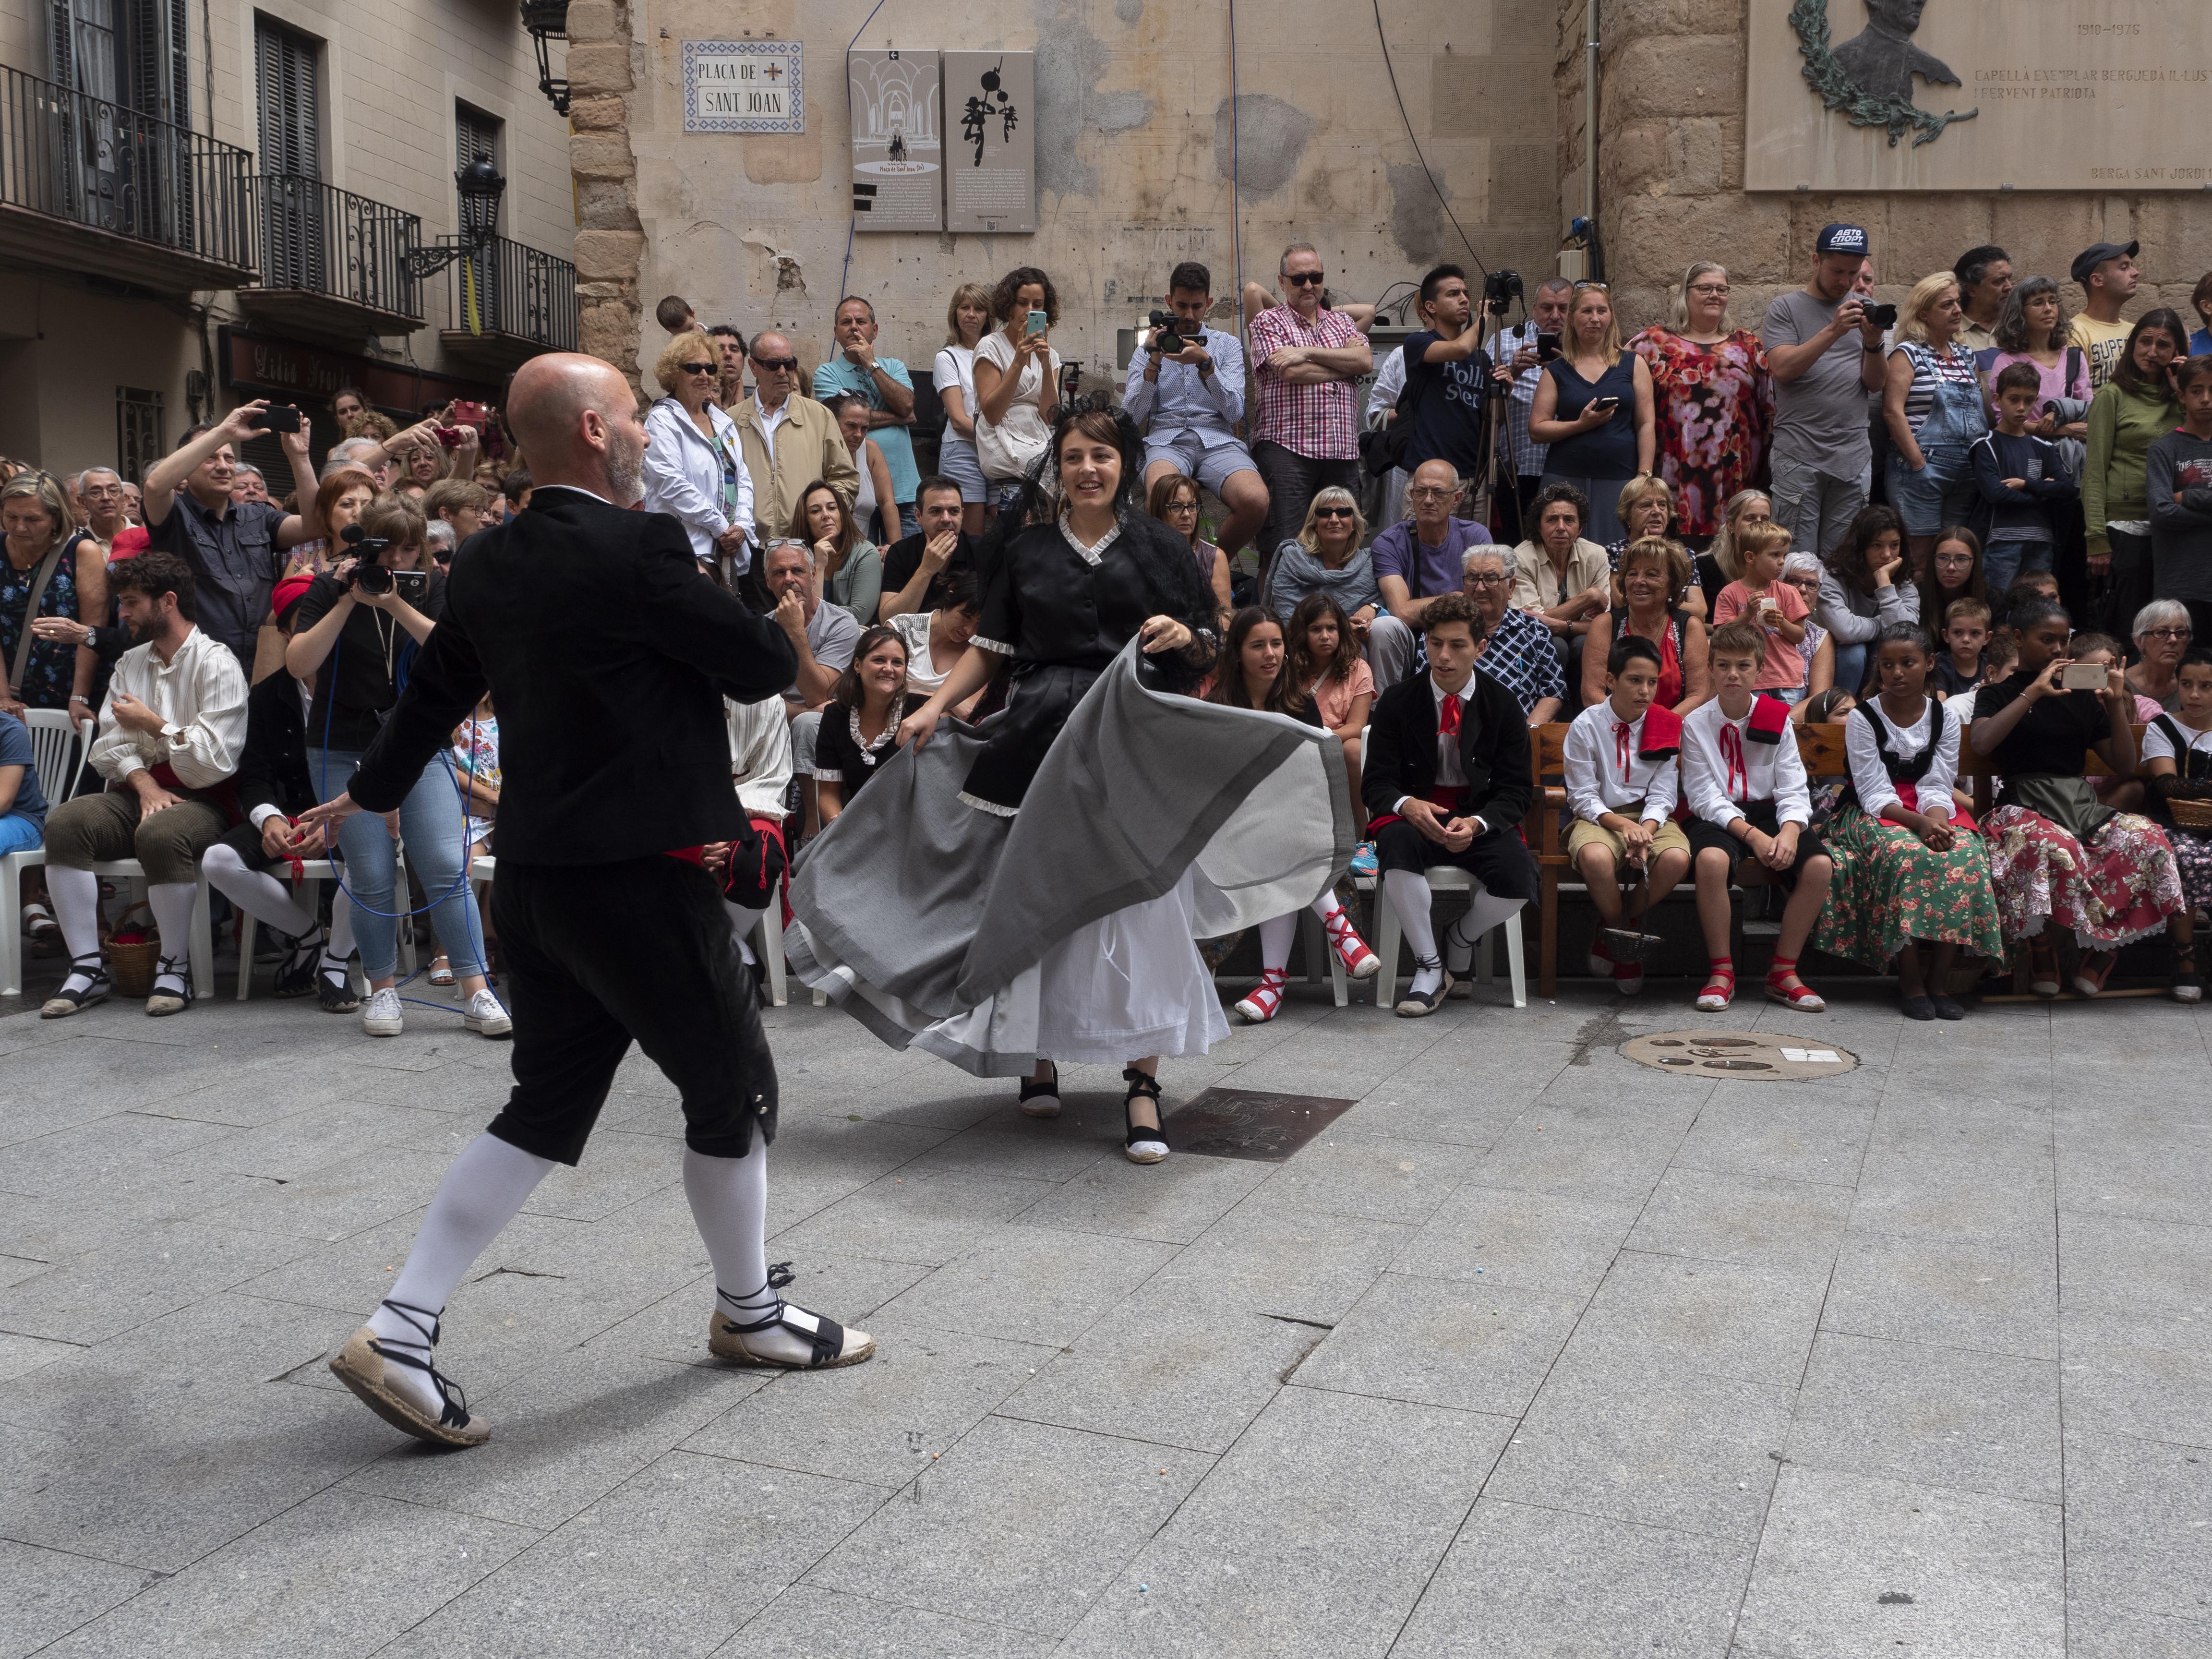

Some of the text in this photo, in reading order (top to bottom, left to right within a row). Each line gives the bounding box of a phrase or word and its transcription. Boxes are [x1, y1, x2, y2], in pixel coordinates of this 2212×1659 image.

[698, 64, 756, 81] PLAÇA DE
[1975, 66, 2029, 81] CAPELLÀ
[2034, 70, 2097, 81] EXEMPLAR
[1981, 88, 2036, 99] FERVENT
[2041, 88, 2095, 99] PATRIOTA
[706, 93, 781, 113] SANT JOAN
[2091, 168, 2130, 179] BERGA
[2134, 168, 2166, 179] SANT
[2170, 168, 2205, 179] JORDI
[255, 345, 297, 384] Lidia
